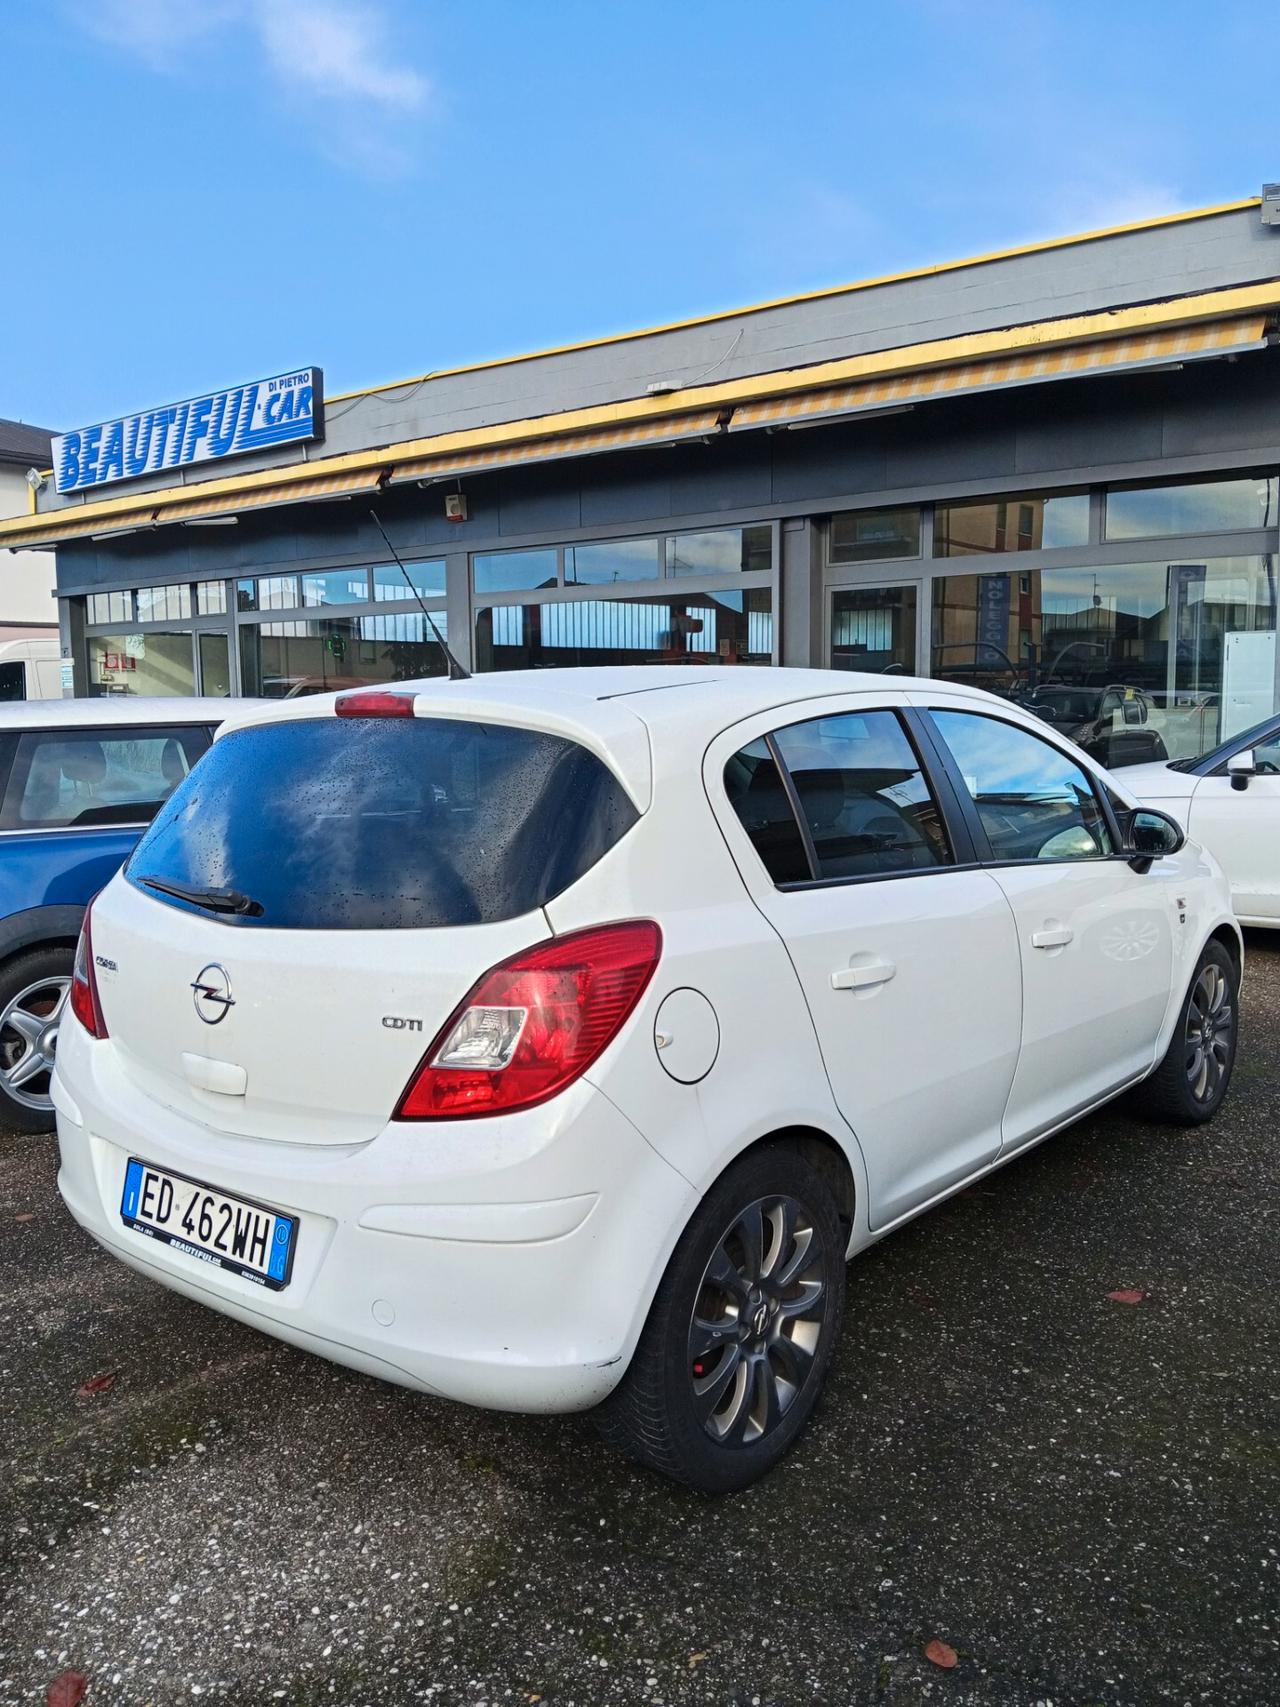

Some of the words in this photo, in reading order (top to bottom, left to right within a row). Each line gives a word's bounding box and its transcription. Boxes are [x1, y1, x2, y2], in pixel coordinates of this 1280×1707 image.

[268, 381, 276, 393] DI
[279, 372, 310, 390] PIETRO
[57, 385, 260, 491] BEAUTIFUL
[261, 385, 313, 425] CAR
[984, 580, 1004, 660] NOLEGGO
[140, 1172, 174, 1225] ED
[181, 1191, 271, 1268] 462WH
[170, 1239, 213, 1262] BEAUTIFUL
